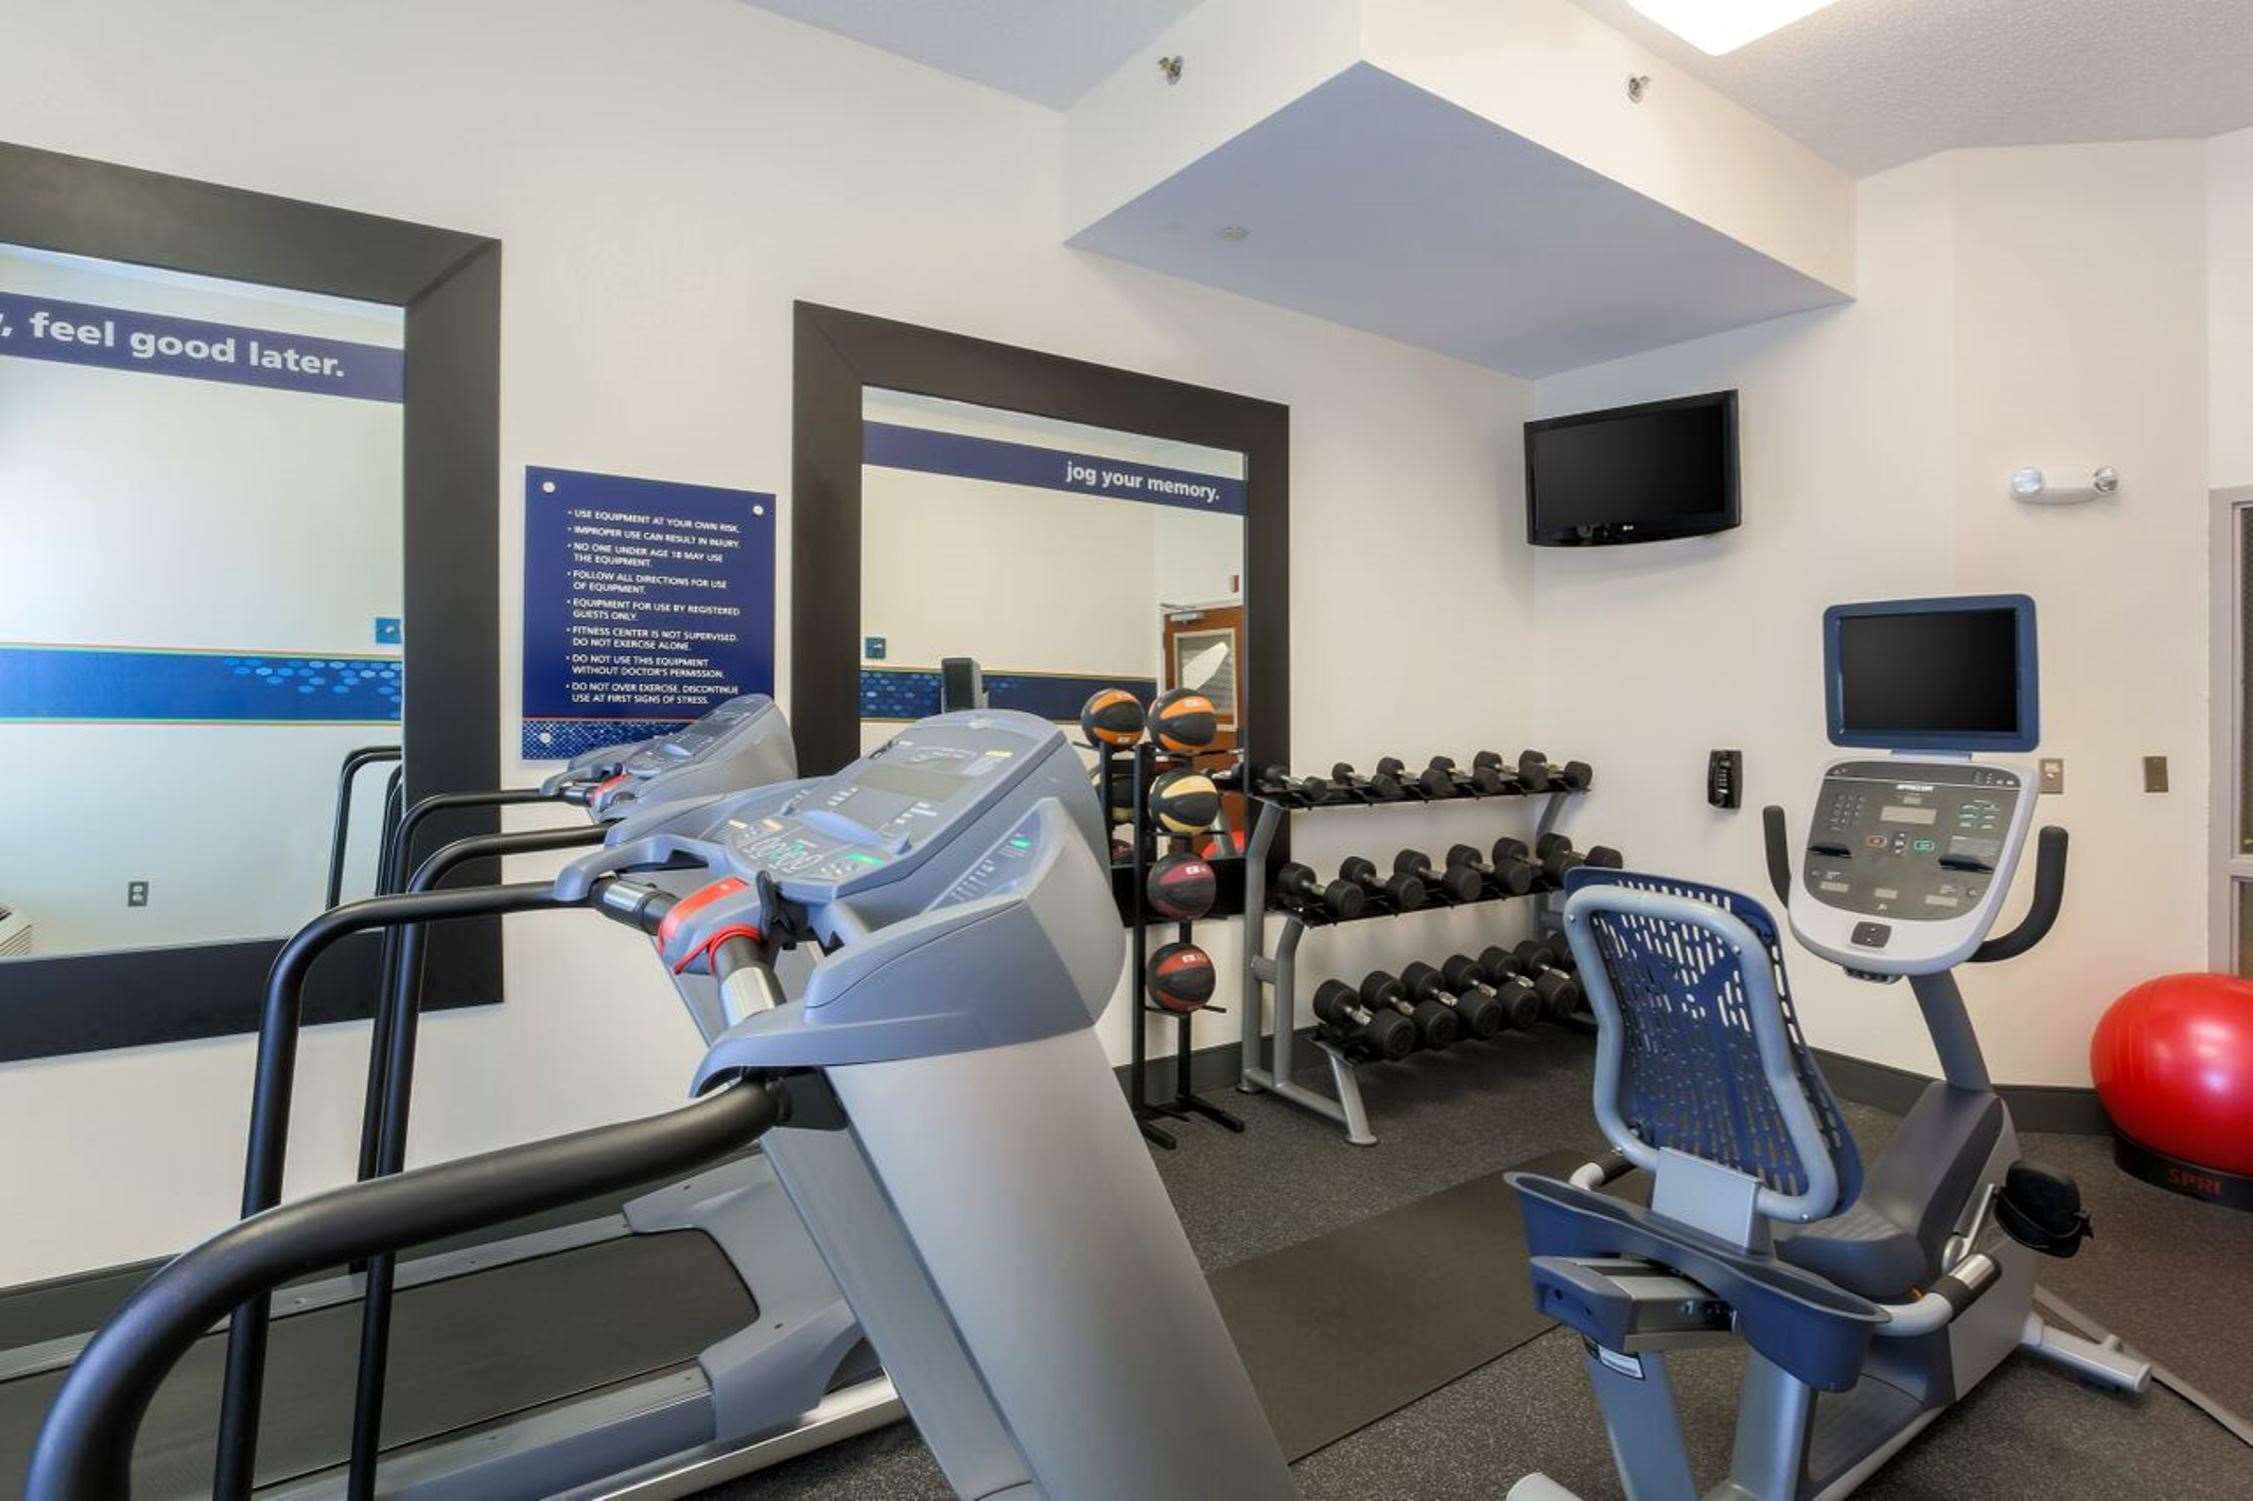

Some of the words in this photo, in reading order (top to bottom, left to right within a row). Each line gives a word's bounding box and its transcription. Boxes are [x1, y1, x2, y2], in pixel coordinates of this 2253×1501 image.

[29, 311, 115, 348] feel
[129, 330, 236, 363] good
[249, 340, 345, 378] later.
[1065, 460, 1097, 486] jog
[1102, 470, 1144, 488] your
[1147, 476, 1221, 503] memory.
[574, 509, 592, 518] USE
[595, 511, 650, 524] EQUIPMENT
[652, 516, 664, 525] AT
[666, 518, 693, 528] YOUR
[694, 521, 718, 530] OWN
[720, 523, 741, 534] RISK.
[574, 526, 622, 537] IMPROPER
[624, 531, 640, 540] USE
[643, 532, 664, 541] CAN
[665, 534, 696, 544] RESULT
[698, 537, 707, 545] IN
[709, 538, 741, 549] INJURY.
[574, 542, 589, 551] NO
[591, 543, 612, 553] ONE
[615, 546, 648, 556] UNDER
[650, 548, 668, 558] AGE
[672, 551, 682, 559] 18
[684, 551, 705, 560] MAY
[707, 554, 723, 563] USE
[574, 553, 592, 563] THE
[573, 570, 615, 580] FOLLOW
[617, 573, 634, 582] ALL
[636, 575, 689, 586] DIRECTIONS
[691, 579, 709, 587] FOR
[710, 580, 727, 589] USE
[573, 581, 587, 590] OF
[573, 597, 631, 608] EQUIPMENT
[633, 602, 651, 611] FOR
[653, 603, 672, 612] USE
[673, 604, 686, 613] BY
[687, 605, 740, 616] REGISTERED
[573, 609, 609, 619] GUESTS
[610, 612, 639, 621] ONLY.
[572, 626, 611, 636] FITNESS
[612, 628, 648, 638] CENTER
[651, 629, 659, 639] IS
[661, 630, 681, 639] NOT
[573, 638, 589, 646] DO
[591, 639, 612, 647] NOT
[613, 639, 656, 650] EXERCISE
[572, 654, 588, 663] DO
[590, 654, 611, 664] NOT
[613, 656, 631, 665] USE
[633, 656, 653, 666] THIS
[656, 657, 709, 668] EQUIPMENT
[572, 665, 619, 675] WITHOUT
[621, 666, 668, 677] DOCTOR'S
[571, 682, 587, 691] DO
[588, 682, 610, 692] NOT
[611, 683, 637, 693] OVER
[682, 685, 739, 696] DISCONTINUE
[572, 694, 590, 703] USE
[593, 694, 605, 703] AT
[607, 695, 632, 703] FIRST
[634, 695, 661, 704] SIGNS
[662, 696, 674, 704] OF
[2167, 1168, 2221, 1196] SPRI
